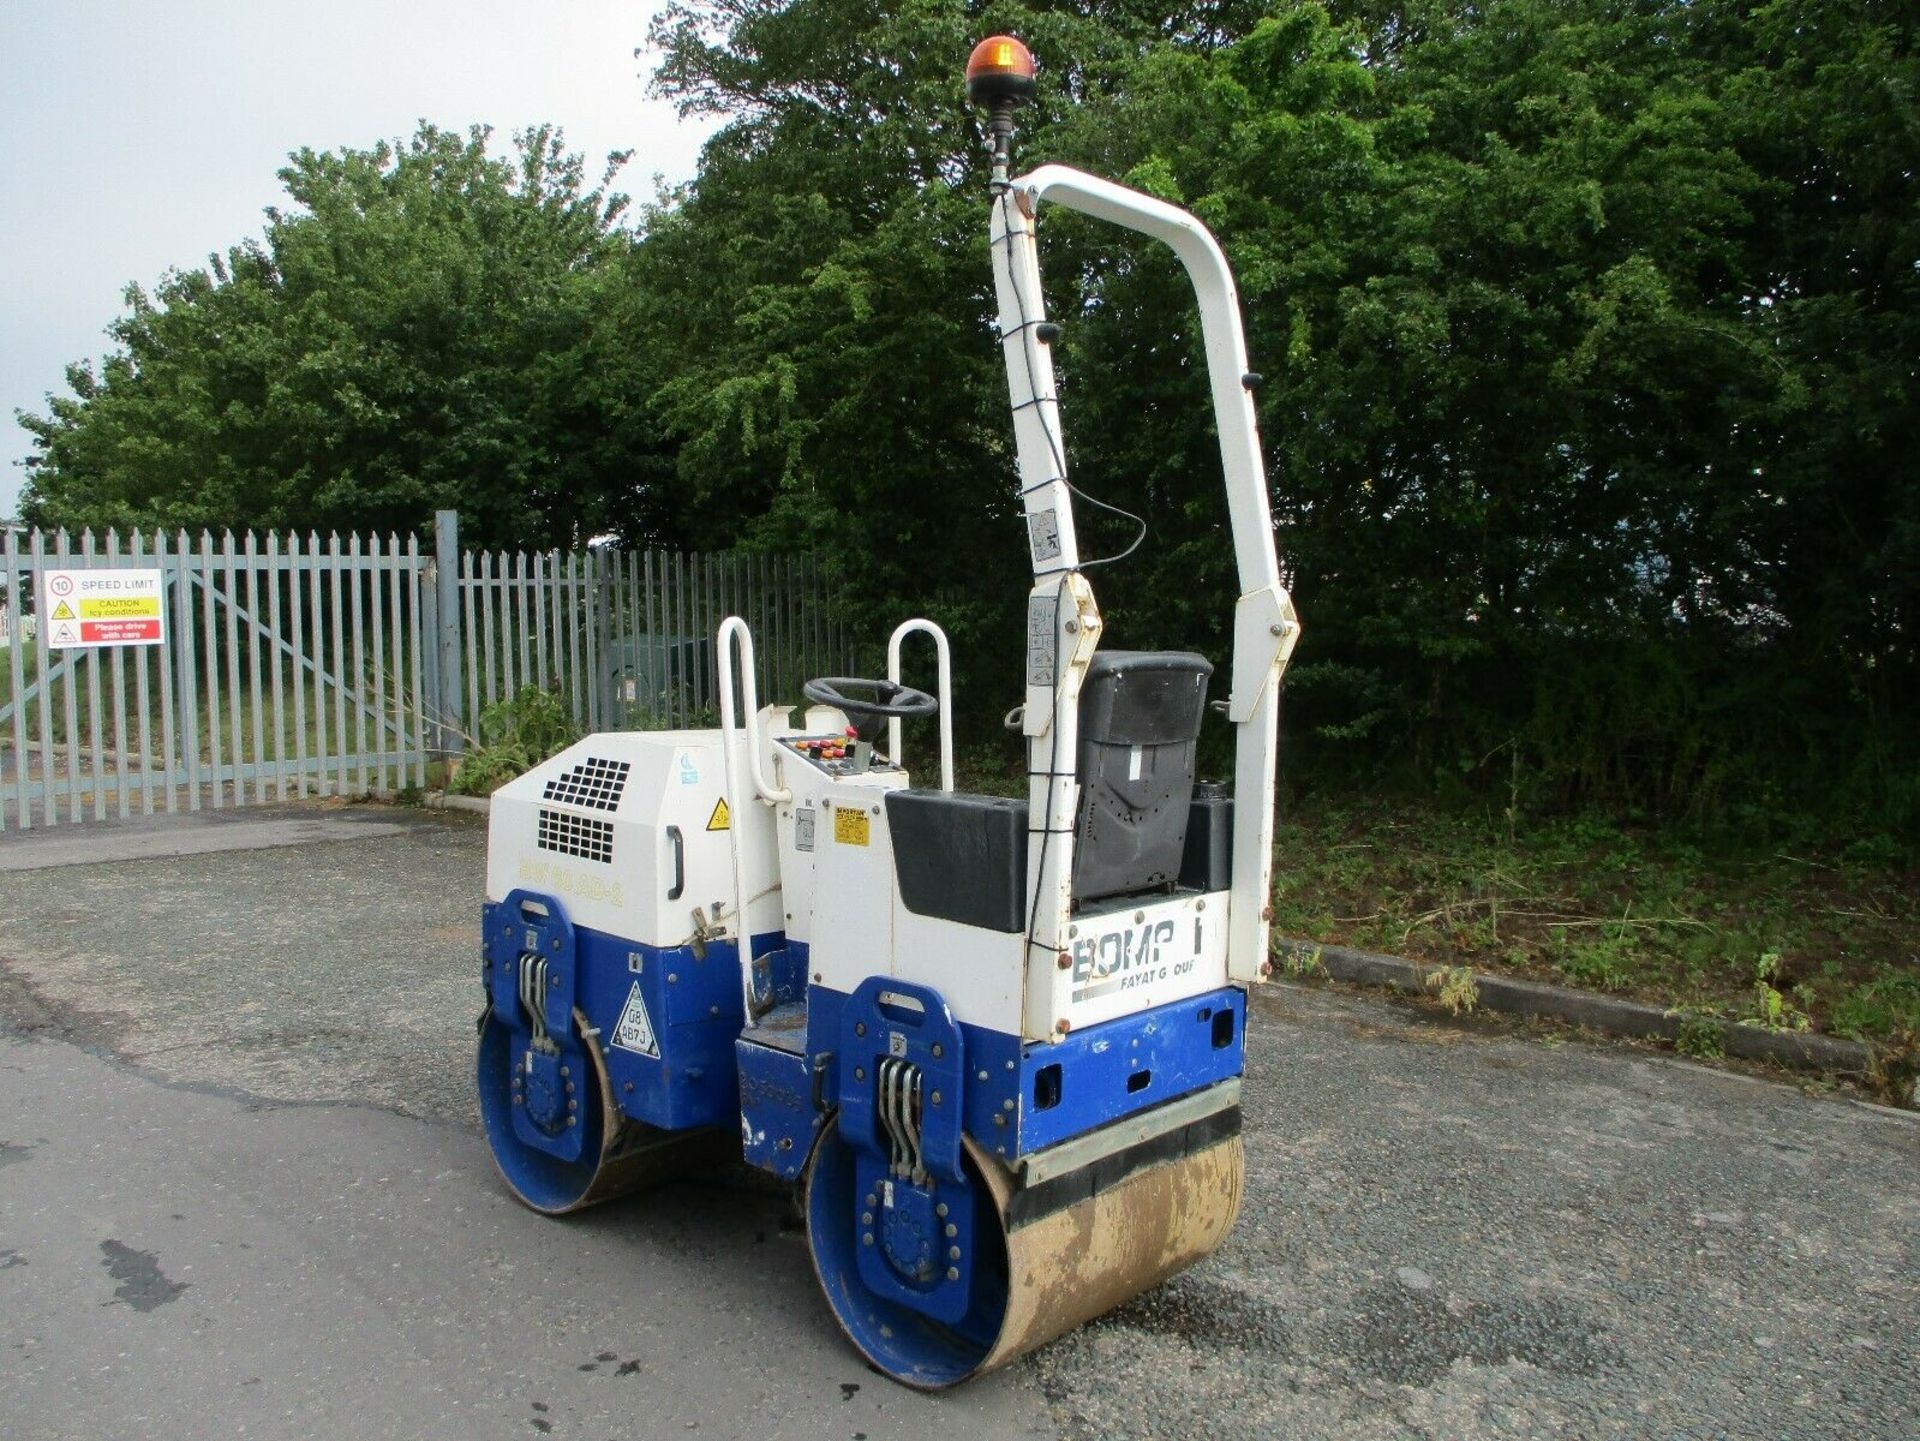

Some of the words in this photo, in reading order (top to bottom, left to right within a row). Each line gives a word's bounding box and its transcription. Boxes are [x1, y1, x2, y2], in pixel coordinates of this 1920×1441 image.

[55, 581, 68, 591] 10
[81, 580, 121, 590] SPEED
[125, 579, 154, 589] LIMIT
[99, 599, 140, 607] CAUTION
[105, 607, 150, 615] conditions
[94, 623, 123, 631] Please
[125, 622, 147, 630] drive
[1120, 970, 1156, 990] FAYAT
[1159, 959, 1195, 980] GOU
